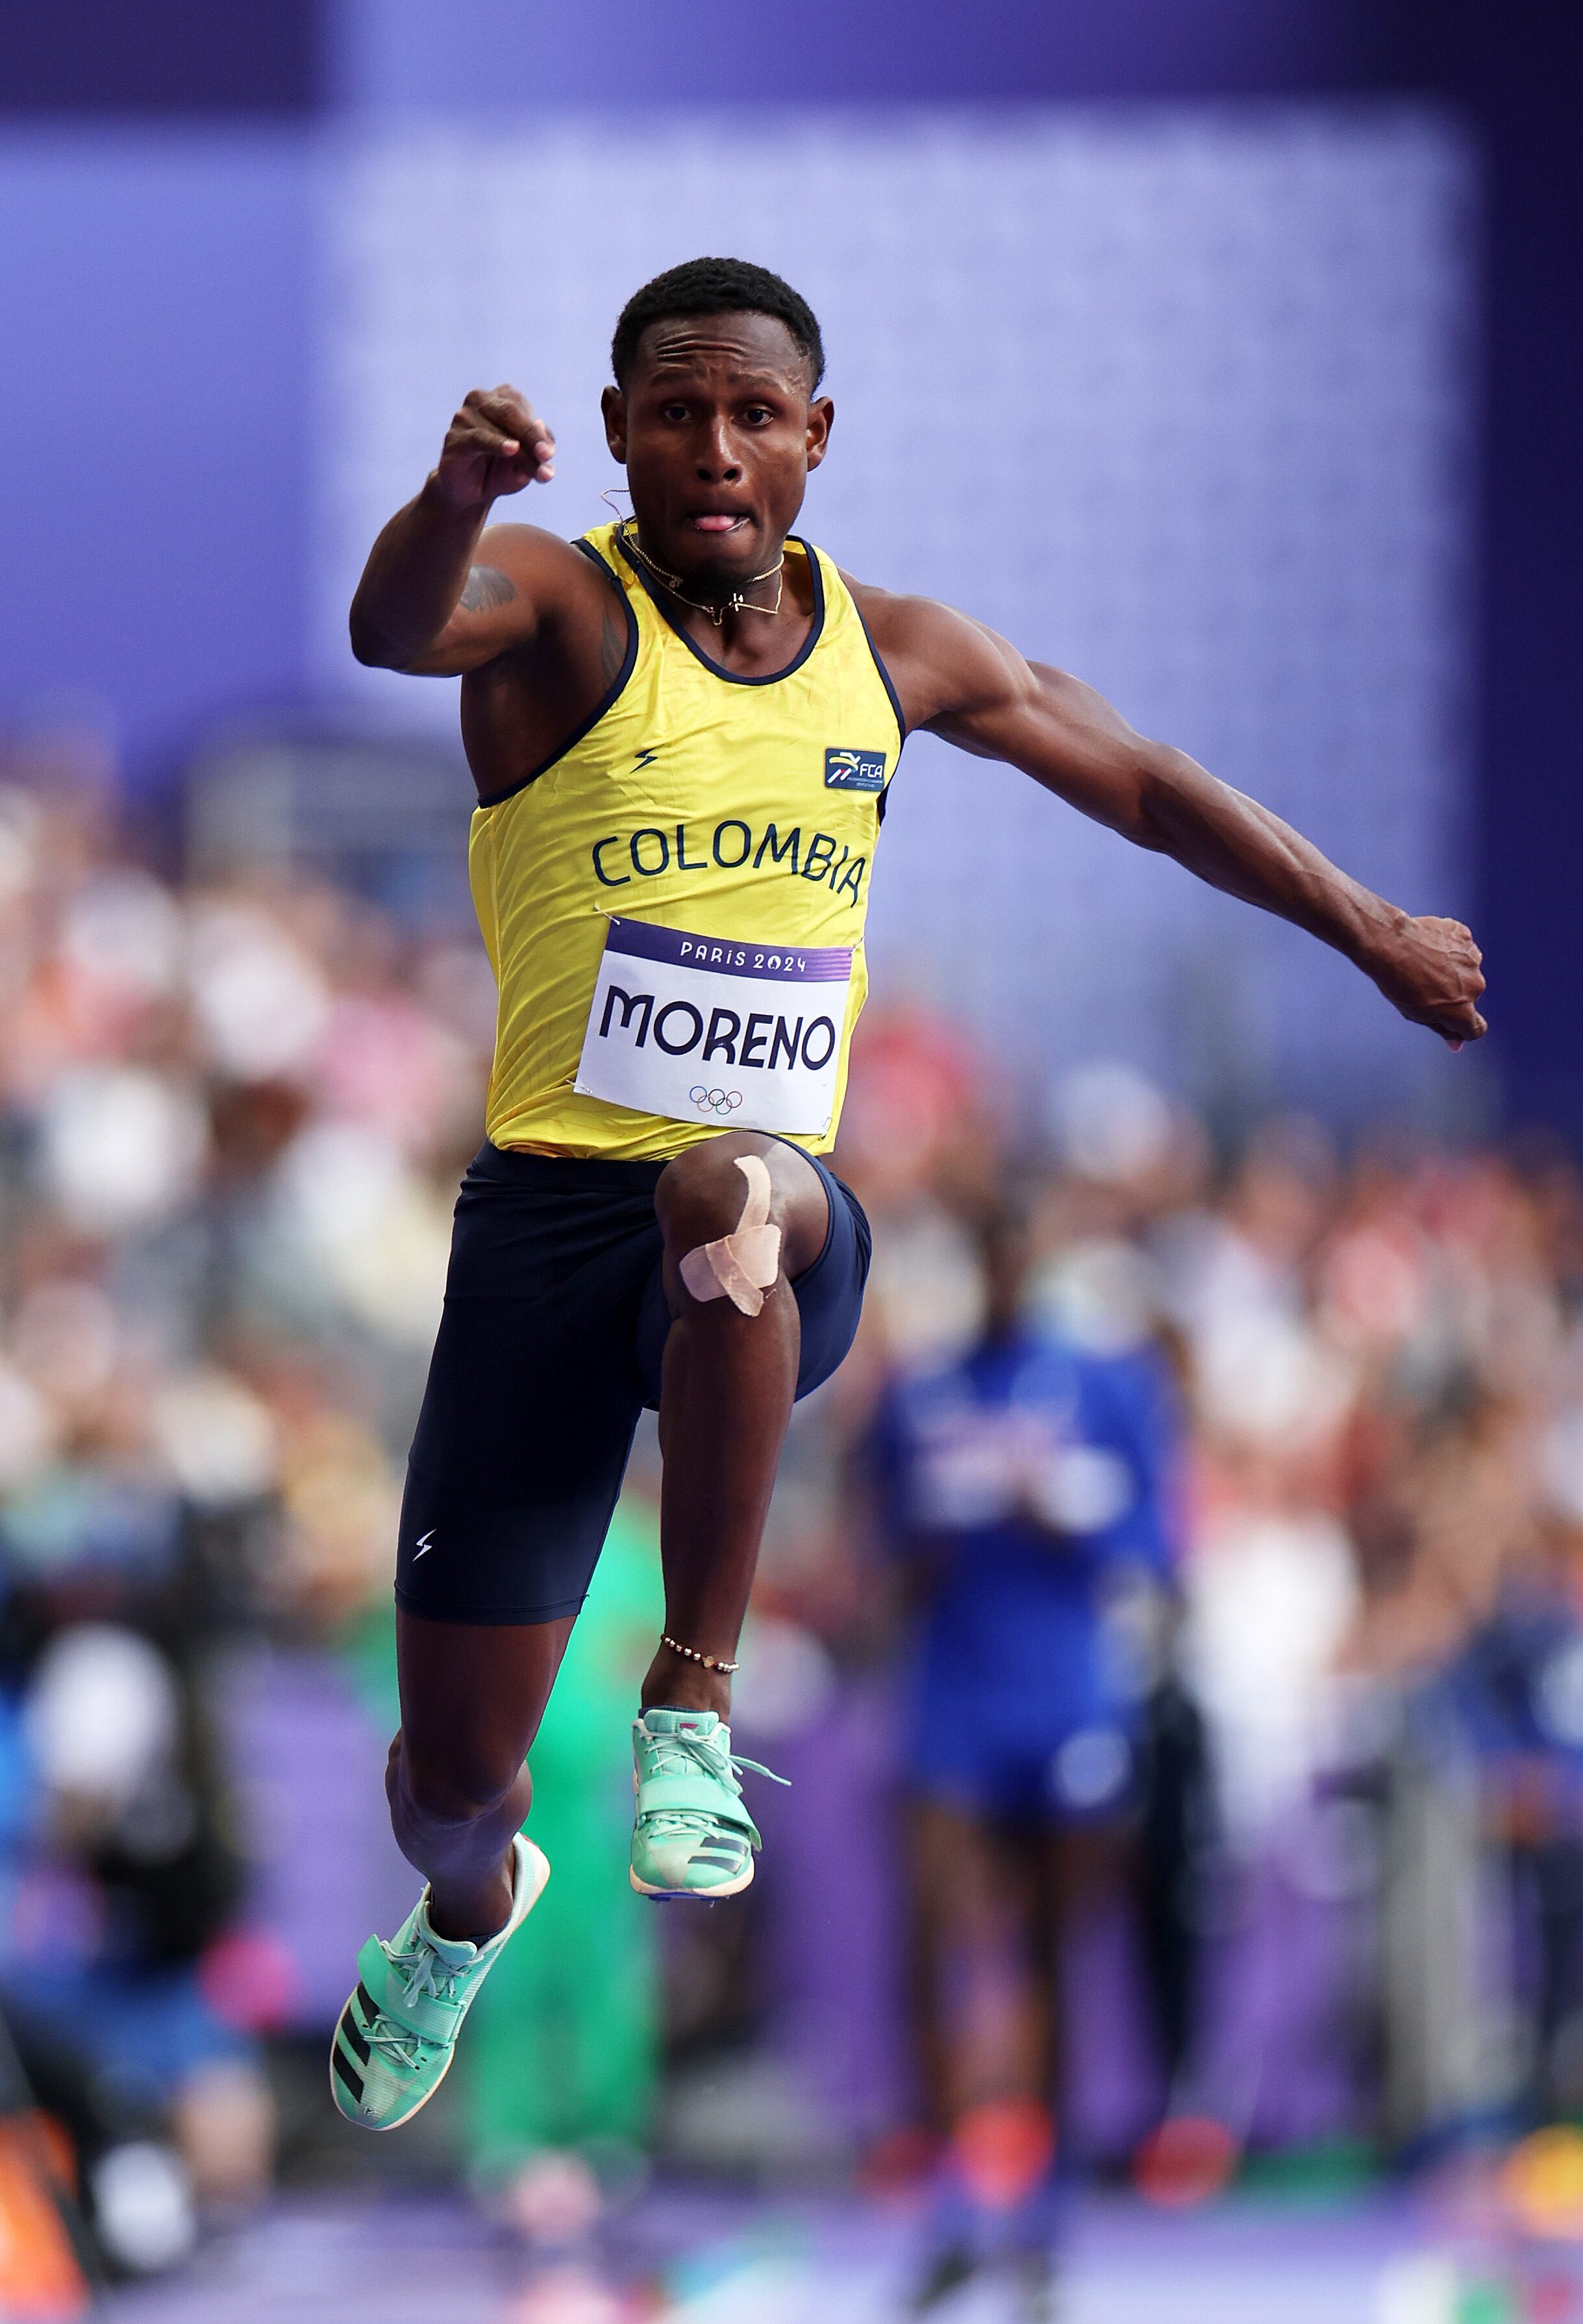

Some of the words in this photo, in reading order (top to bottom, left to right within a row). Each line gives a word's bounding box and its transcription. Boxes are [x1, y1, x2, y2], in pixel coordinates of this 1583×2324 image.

[860, 763, 883, 778] FCA
[592, 820, 866, 908] COLOMBIA
[753, 953, 807, 973] 2024
[599, 985, 836, 1071] MORENO
